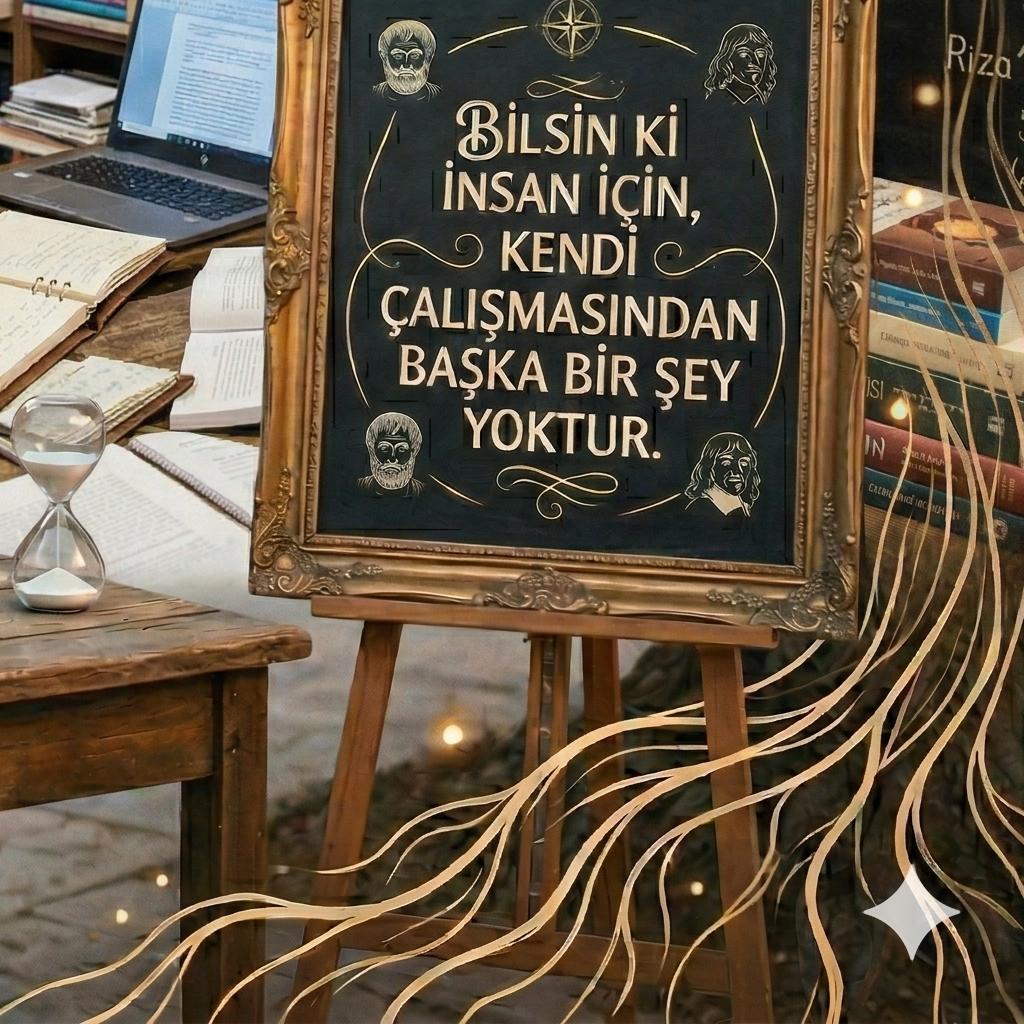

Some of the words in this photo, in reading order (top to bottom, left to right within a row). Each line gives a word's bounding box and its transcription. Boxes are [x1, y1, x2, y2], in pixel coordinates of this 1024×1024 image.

[635, 104, 679, 157] Kİ
[442, 159, 581, 215] İNSAN
[597, 163, 702, 227] İÇİN,
[500, 224, 638, 276] KENDİ
[380, 284, 758, 343] ÇALIŞMASINDAN
[398, 344, 548, 402] BAŞKA
[564, 343, 639, 398] BİR
[654, 356, 742, 412] ŞEY
[463, 407, 662, 460] YOKTUR.
